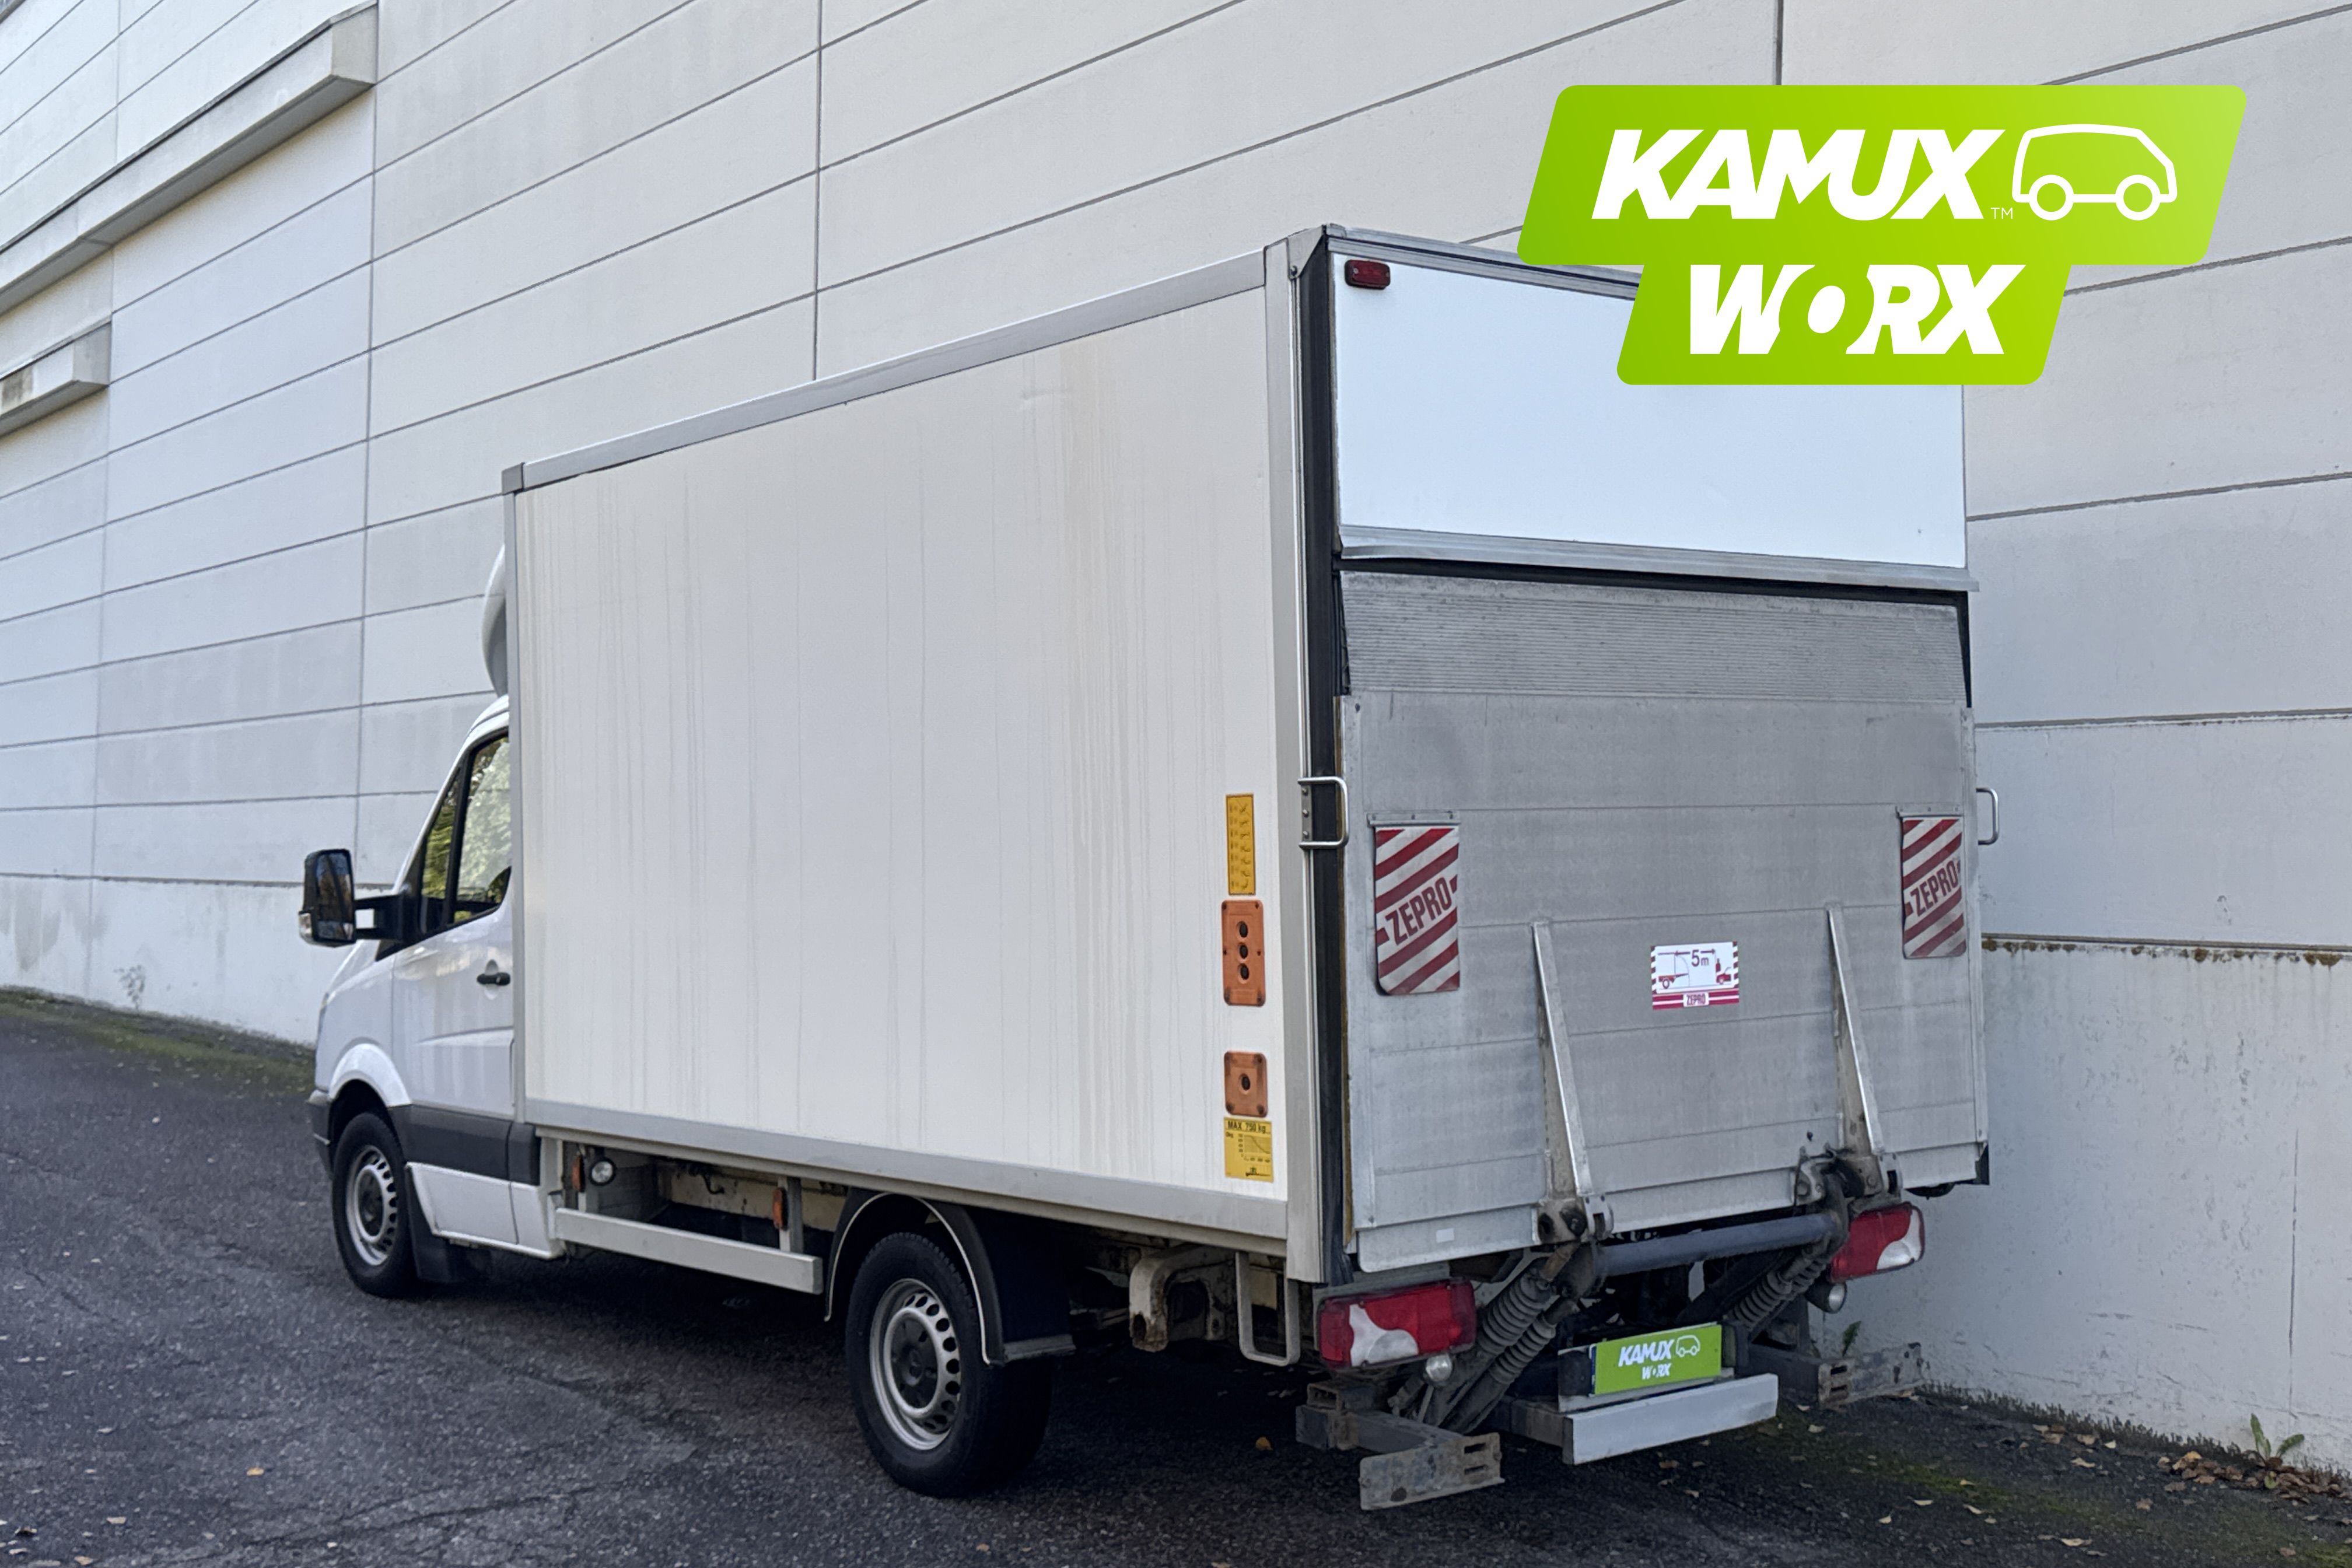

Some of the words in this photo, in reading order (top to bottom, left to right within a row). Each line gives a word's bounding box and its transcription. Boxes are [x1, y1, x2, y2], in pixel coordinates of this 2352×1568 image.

[1910, 860, 1959, 917] ZEPRO
[1385, 877, 1452, 946] ZEPRO
[1686, 993, 1706, 1006] ZEPRO
[1227, 1121, 1242, 1130] MAX
[1618, 1339, 1675, 1367] KAMUX
